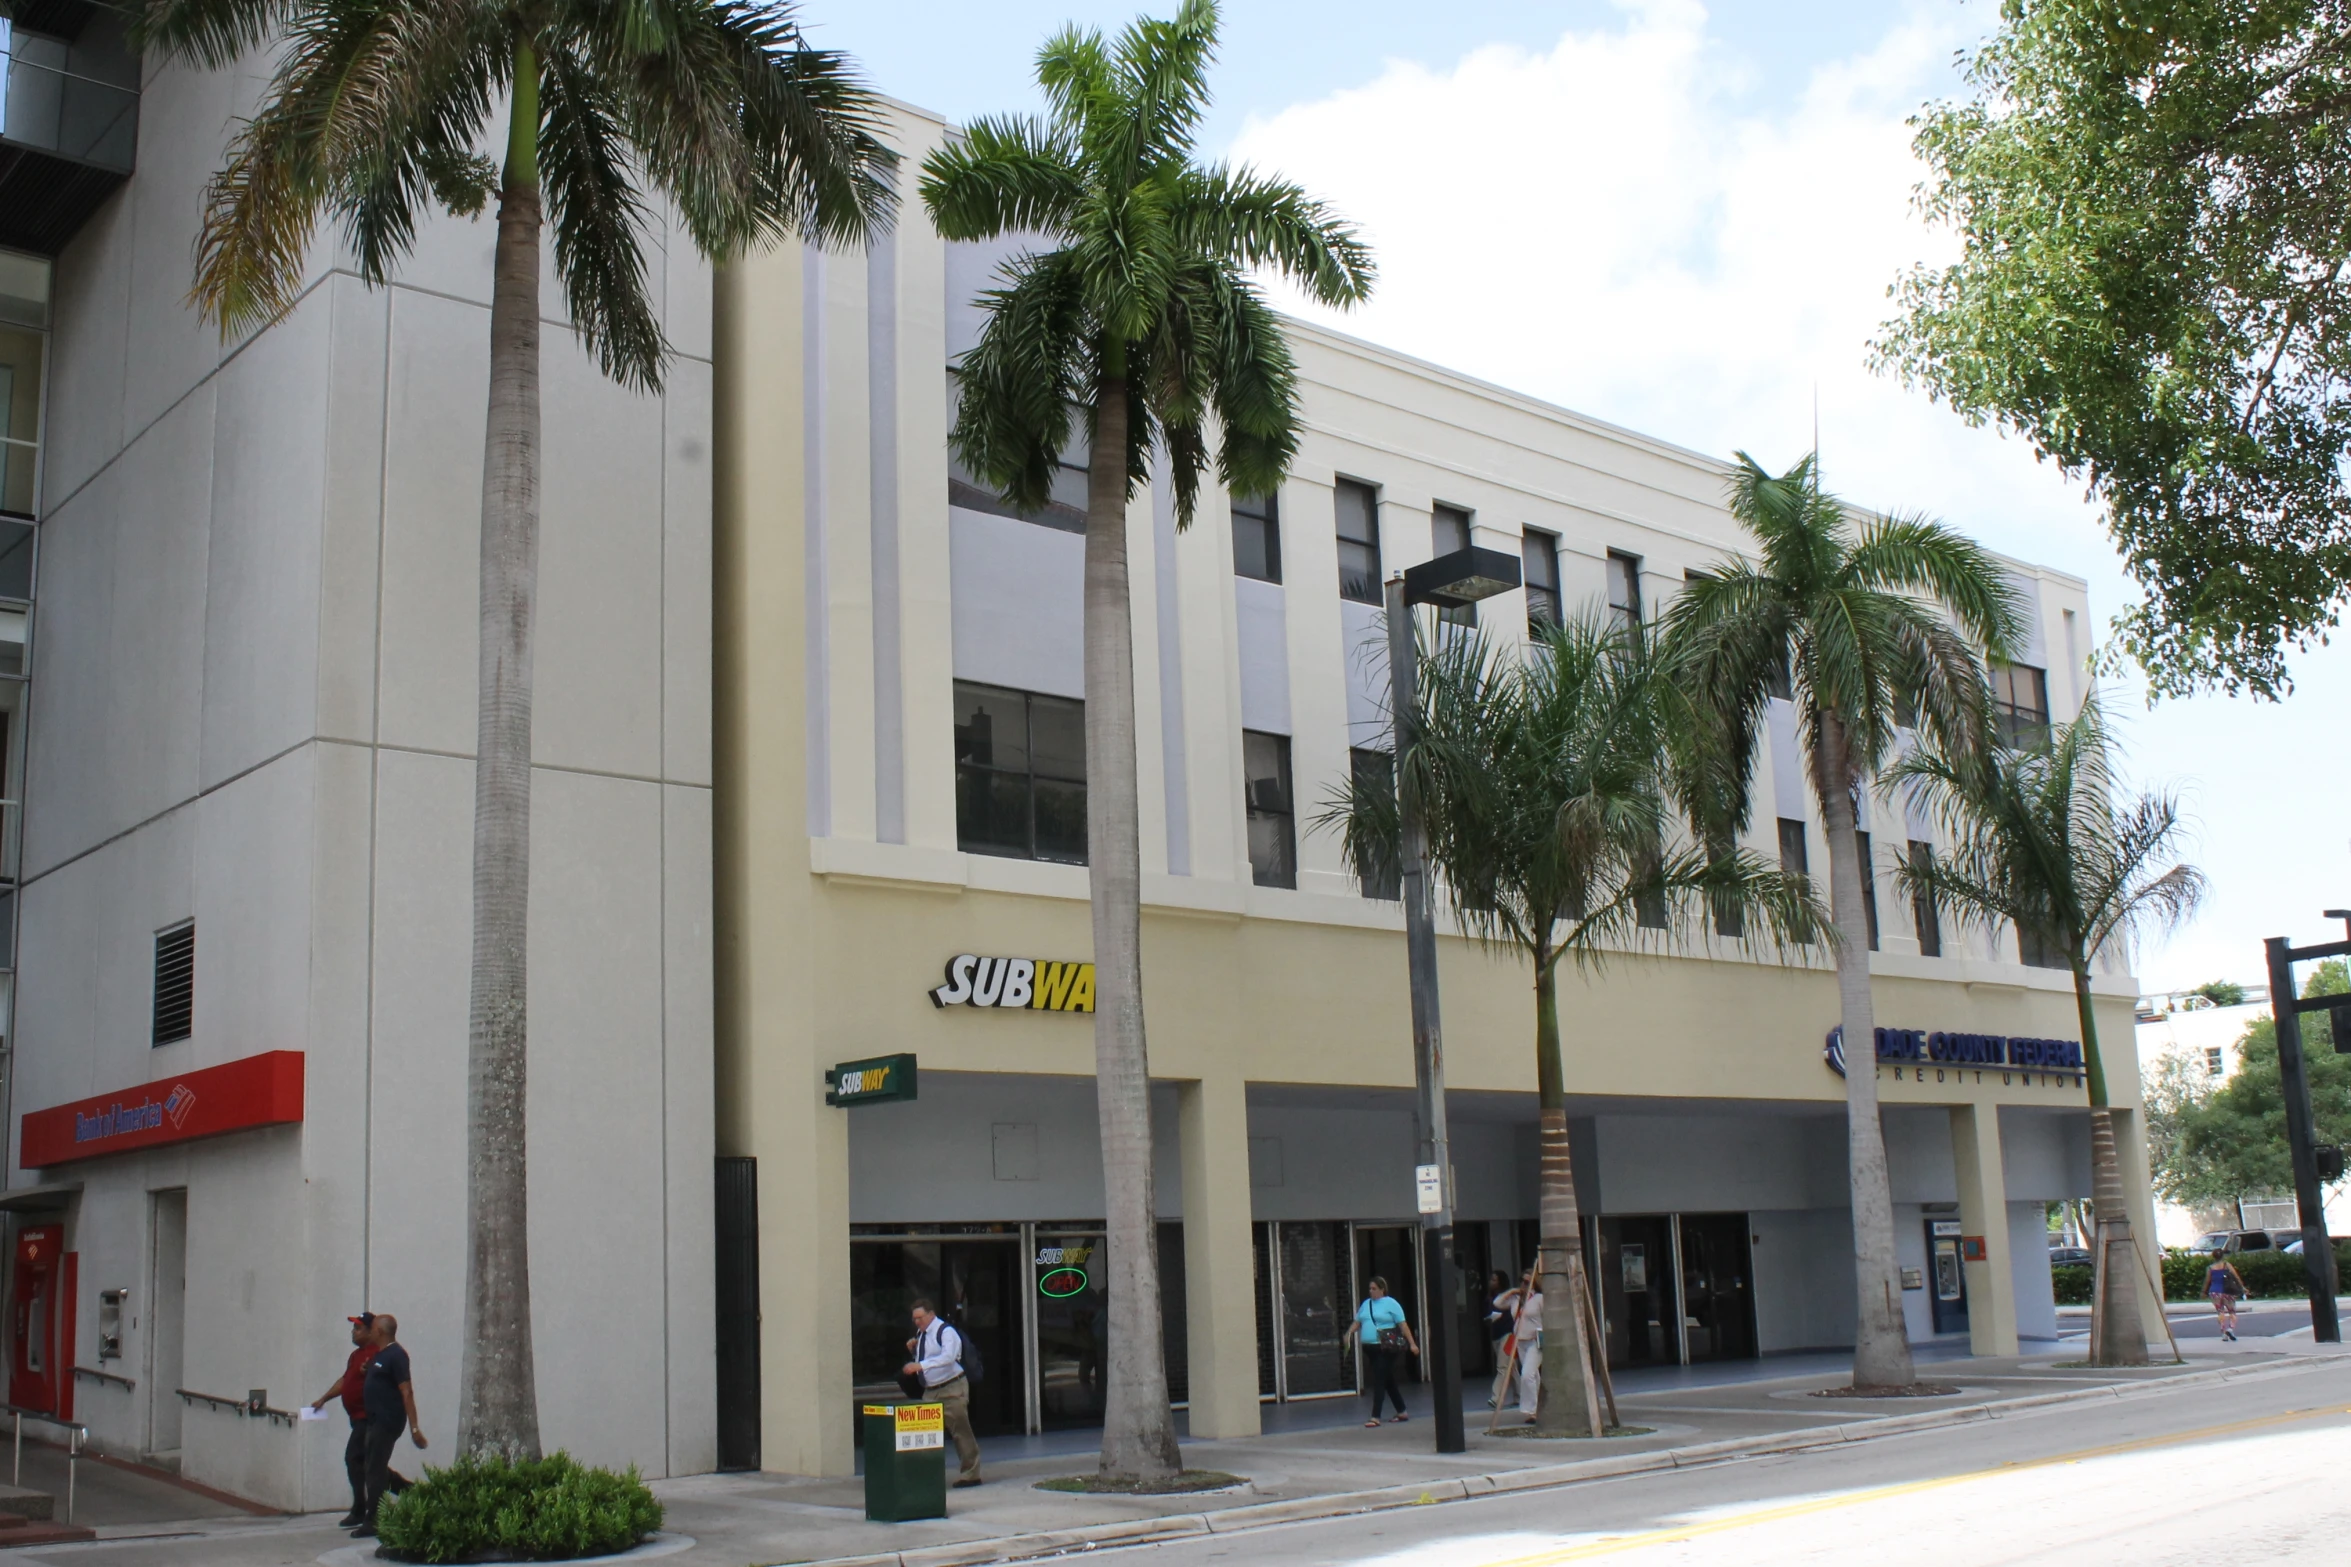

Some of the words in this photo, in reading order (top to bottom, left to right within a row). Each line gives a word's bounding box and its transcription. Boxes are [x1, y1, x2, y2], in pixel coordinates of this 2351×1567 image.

[930, 954, 1096, 1012] SUBWA
[1874, 1027, 1928, 1059] DADE
[1928, 1031, 2006, 1063] COUNTY
[838, 1065, 890, 1096] SUBWAY
[2003, 1071, 2082, 1089] UNION
[76, 1108, 102, 1143] Bank
[103, 1104, 115, 1138] of
[115, 1096, 161, 1134] America
[1035, 1247, 1093, 1265] SUBWAY
[1046, 1275, 1081, 1292] OPEN
[898, 1407, 916, 1422] New
[916, 1406, 941, 1421] Times
